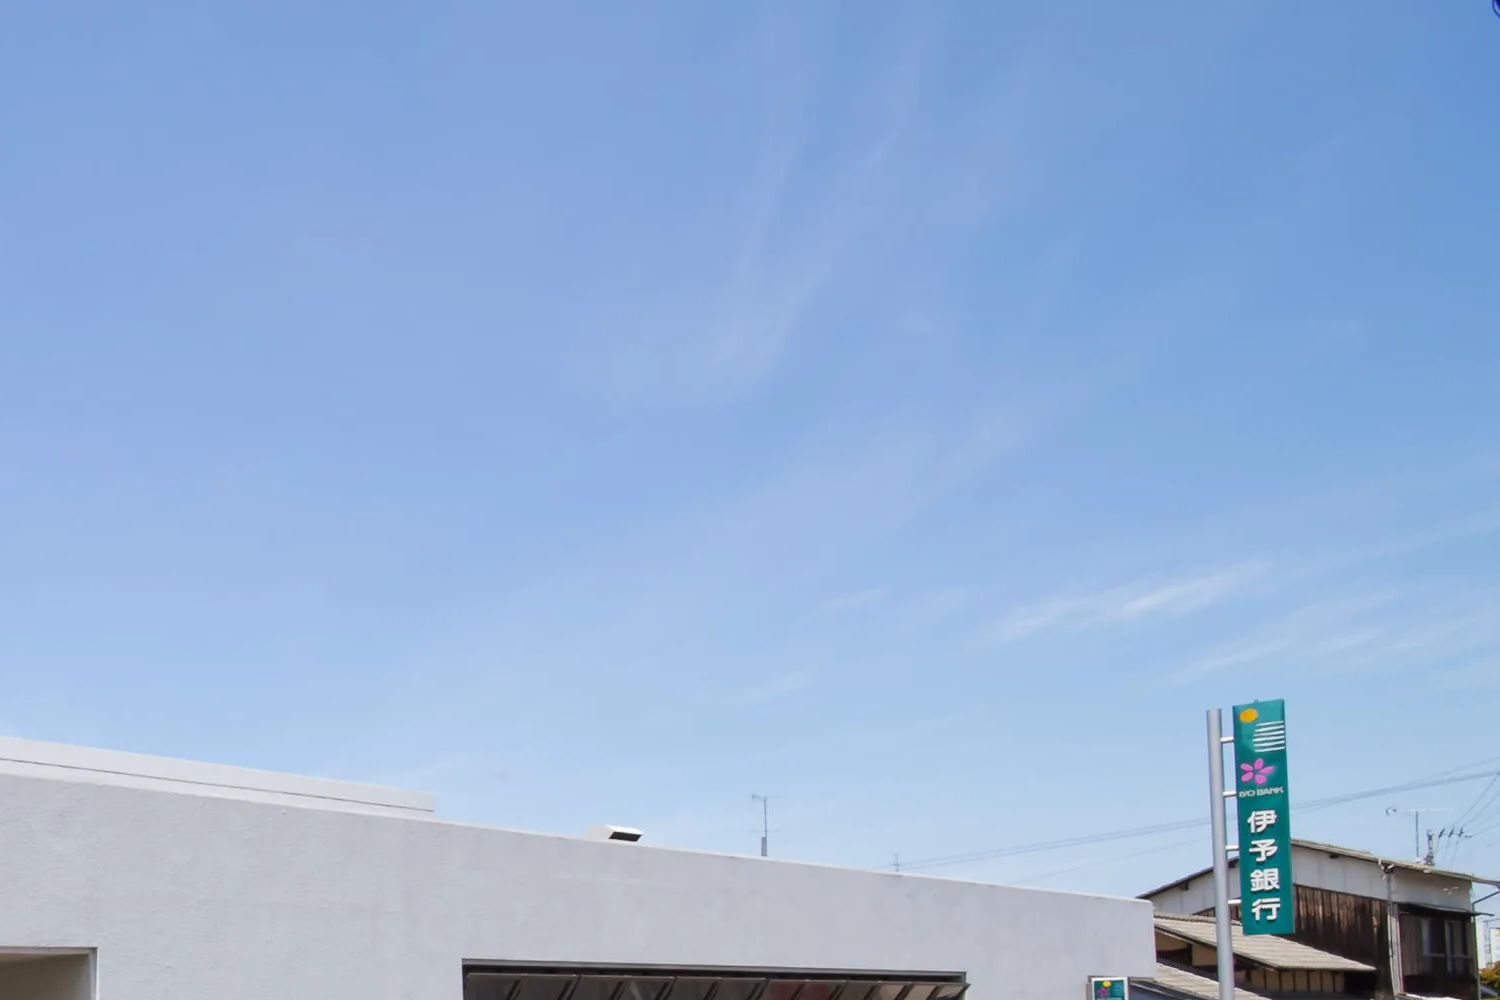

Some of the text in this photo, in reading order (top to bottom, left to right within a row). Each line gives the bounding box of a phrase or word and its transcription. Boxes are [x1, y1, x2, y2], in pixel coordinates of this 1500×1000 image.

[1256, 785, 1284, 796] BANK
[1247, 809, 1281, 921] 伊予銀行
